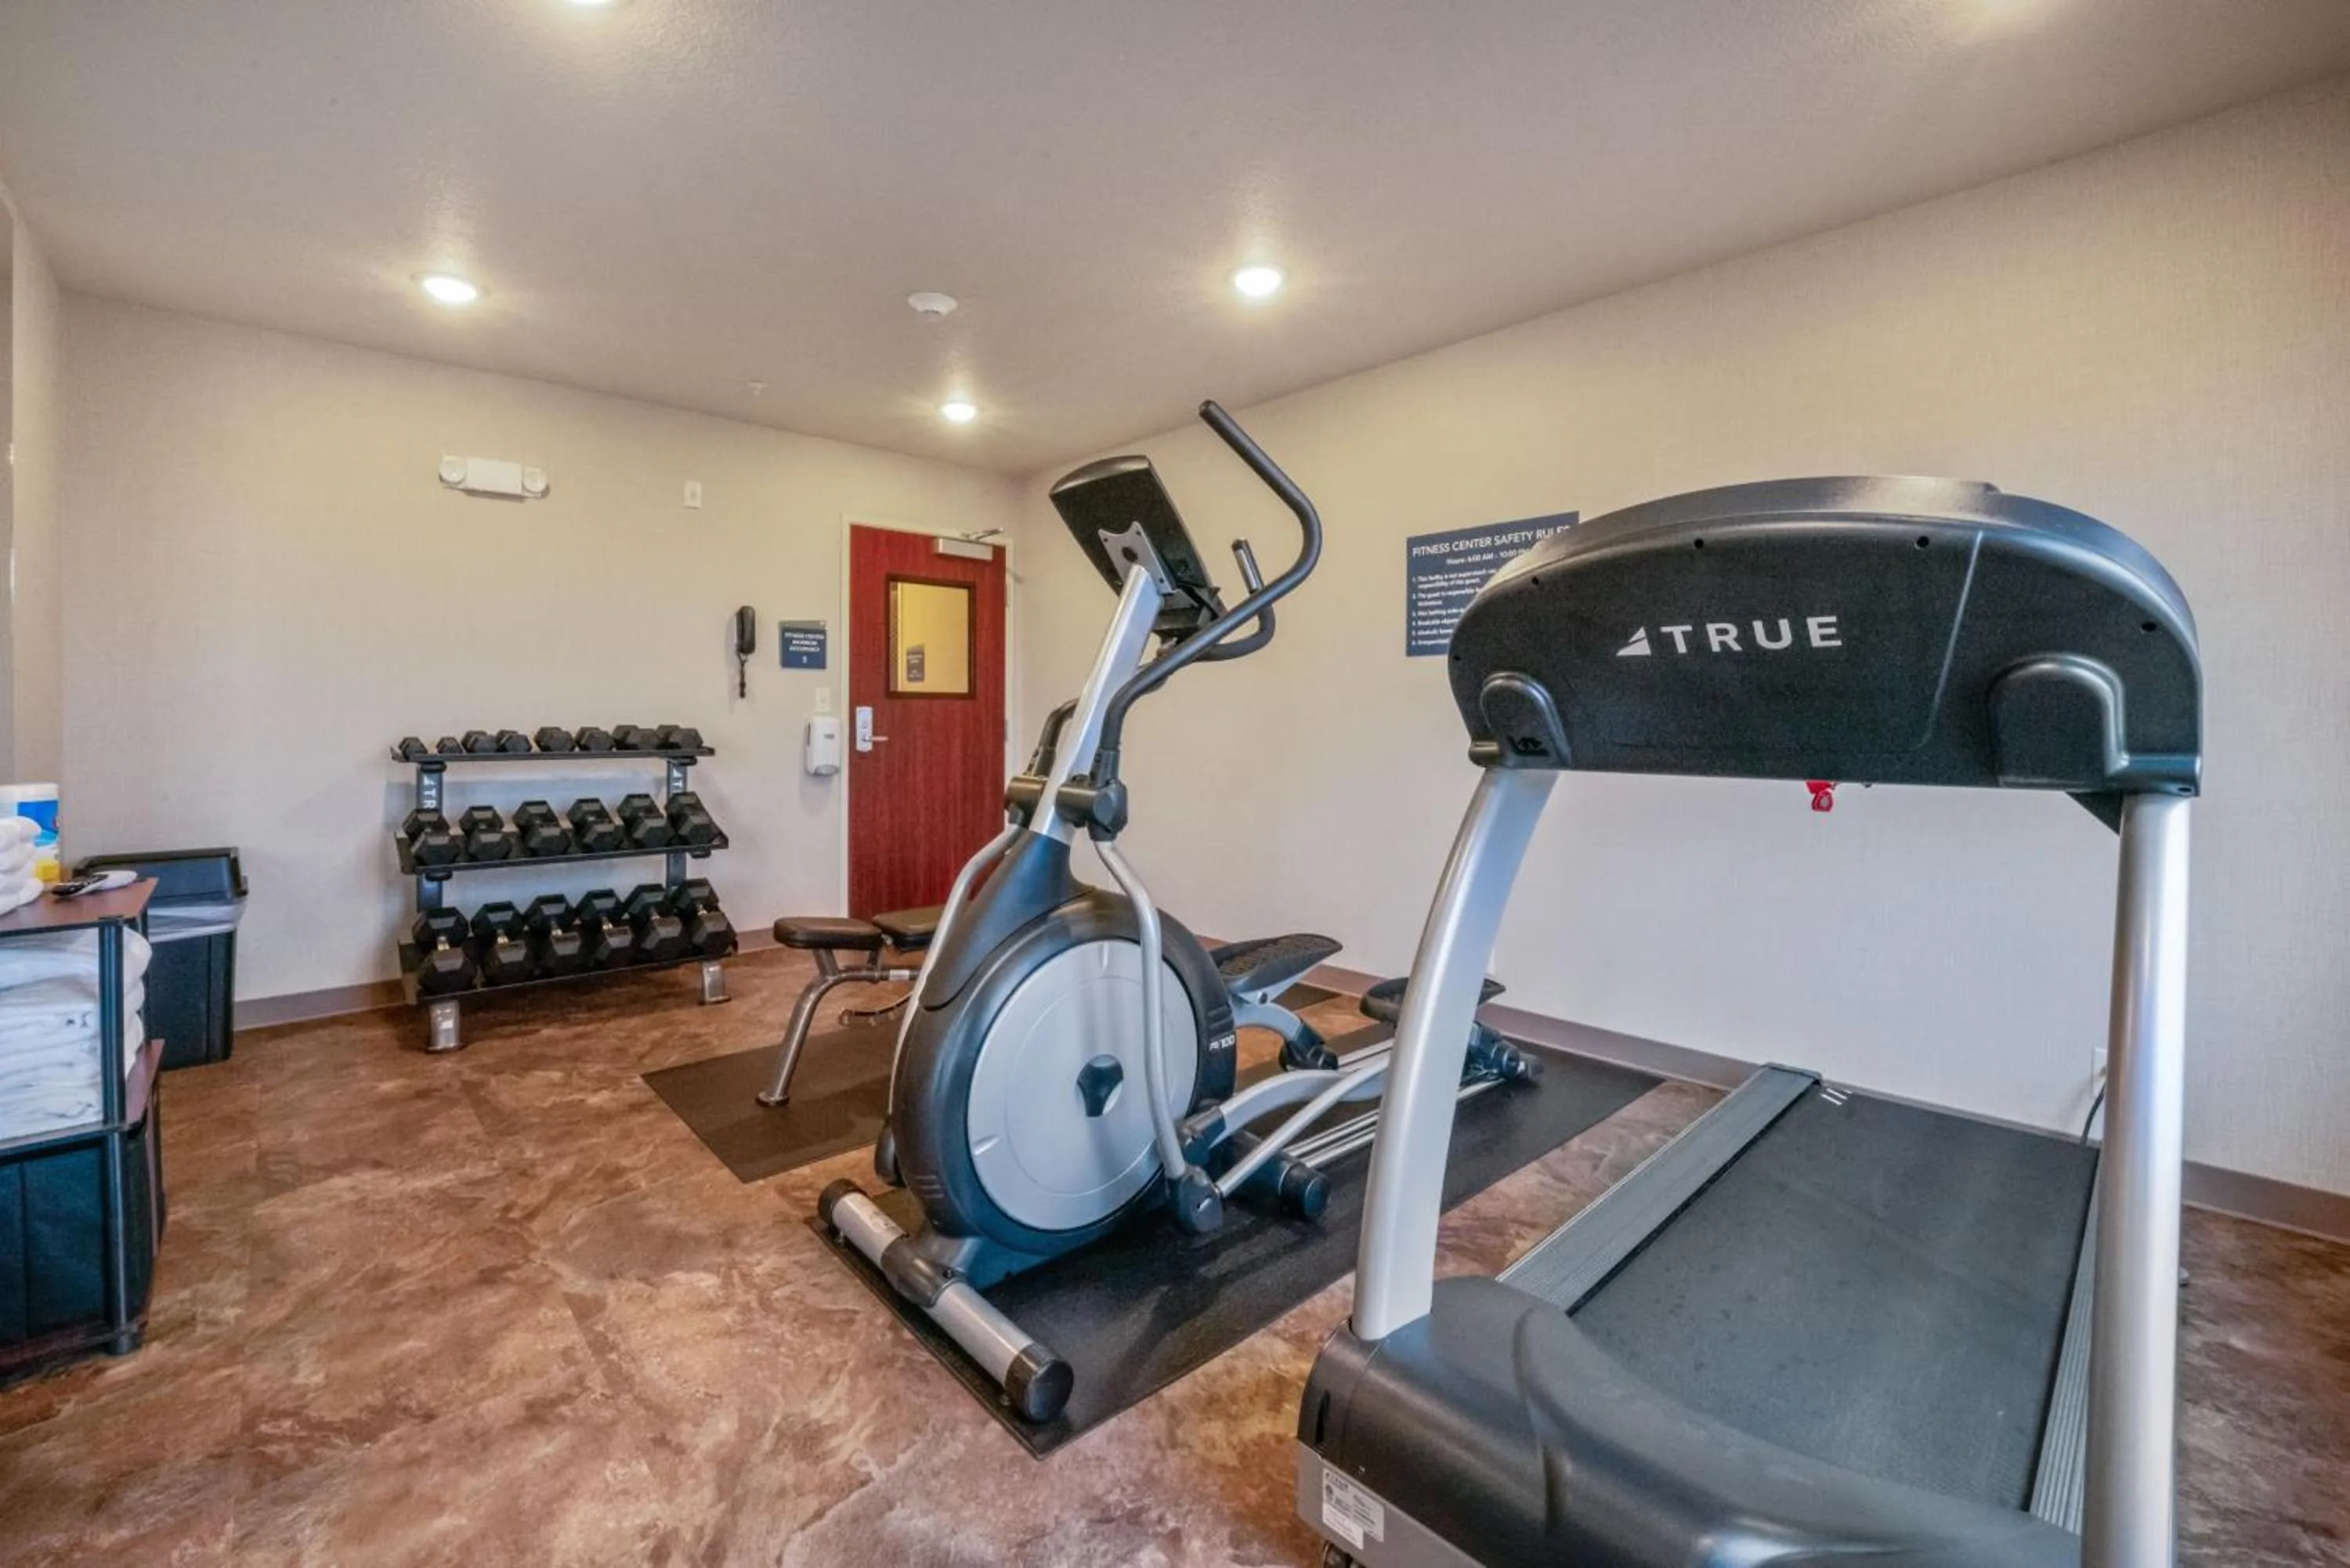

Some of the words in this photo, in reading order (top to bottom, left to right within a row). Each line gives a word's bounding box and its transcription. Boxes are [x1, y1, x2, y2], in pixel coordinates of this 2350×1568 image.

[1412, 543, 1450, 557] FITNESS
[1452, 537, 1492, 551] CENTER
[1493, 531, 1534, 546] SAFETY
[1660, 616, 1842, 653] TRUE
